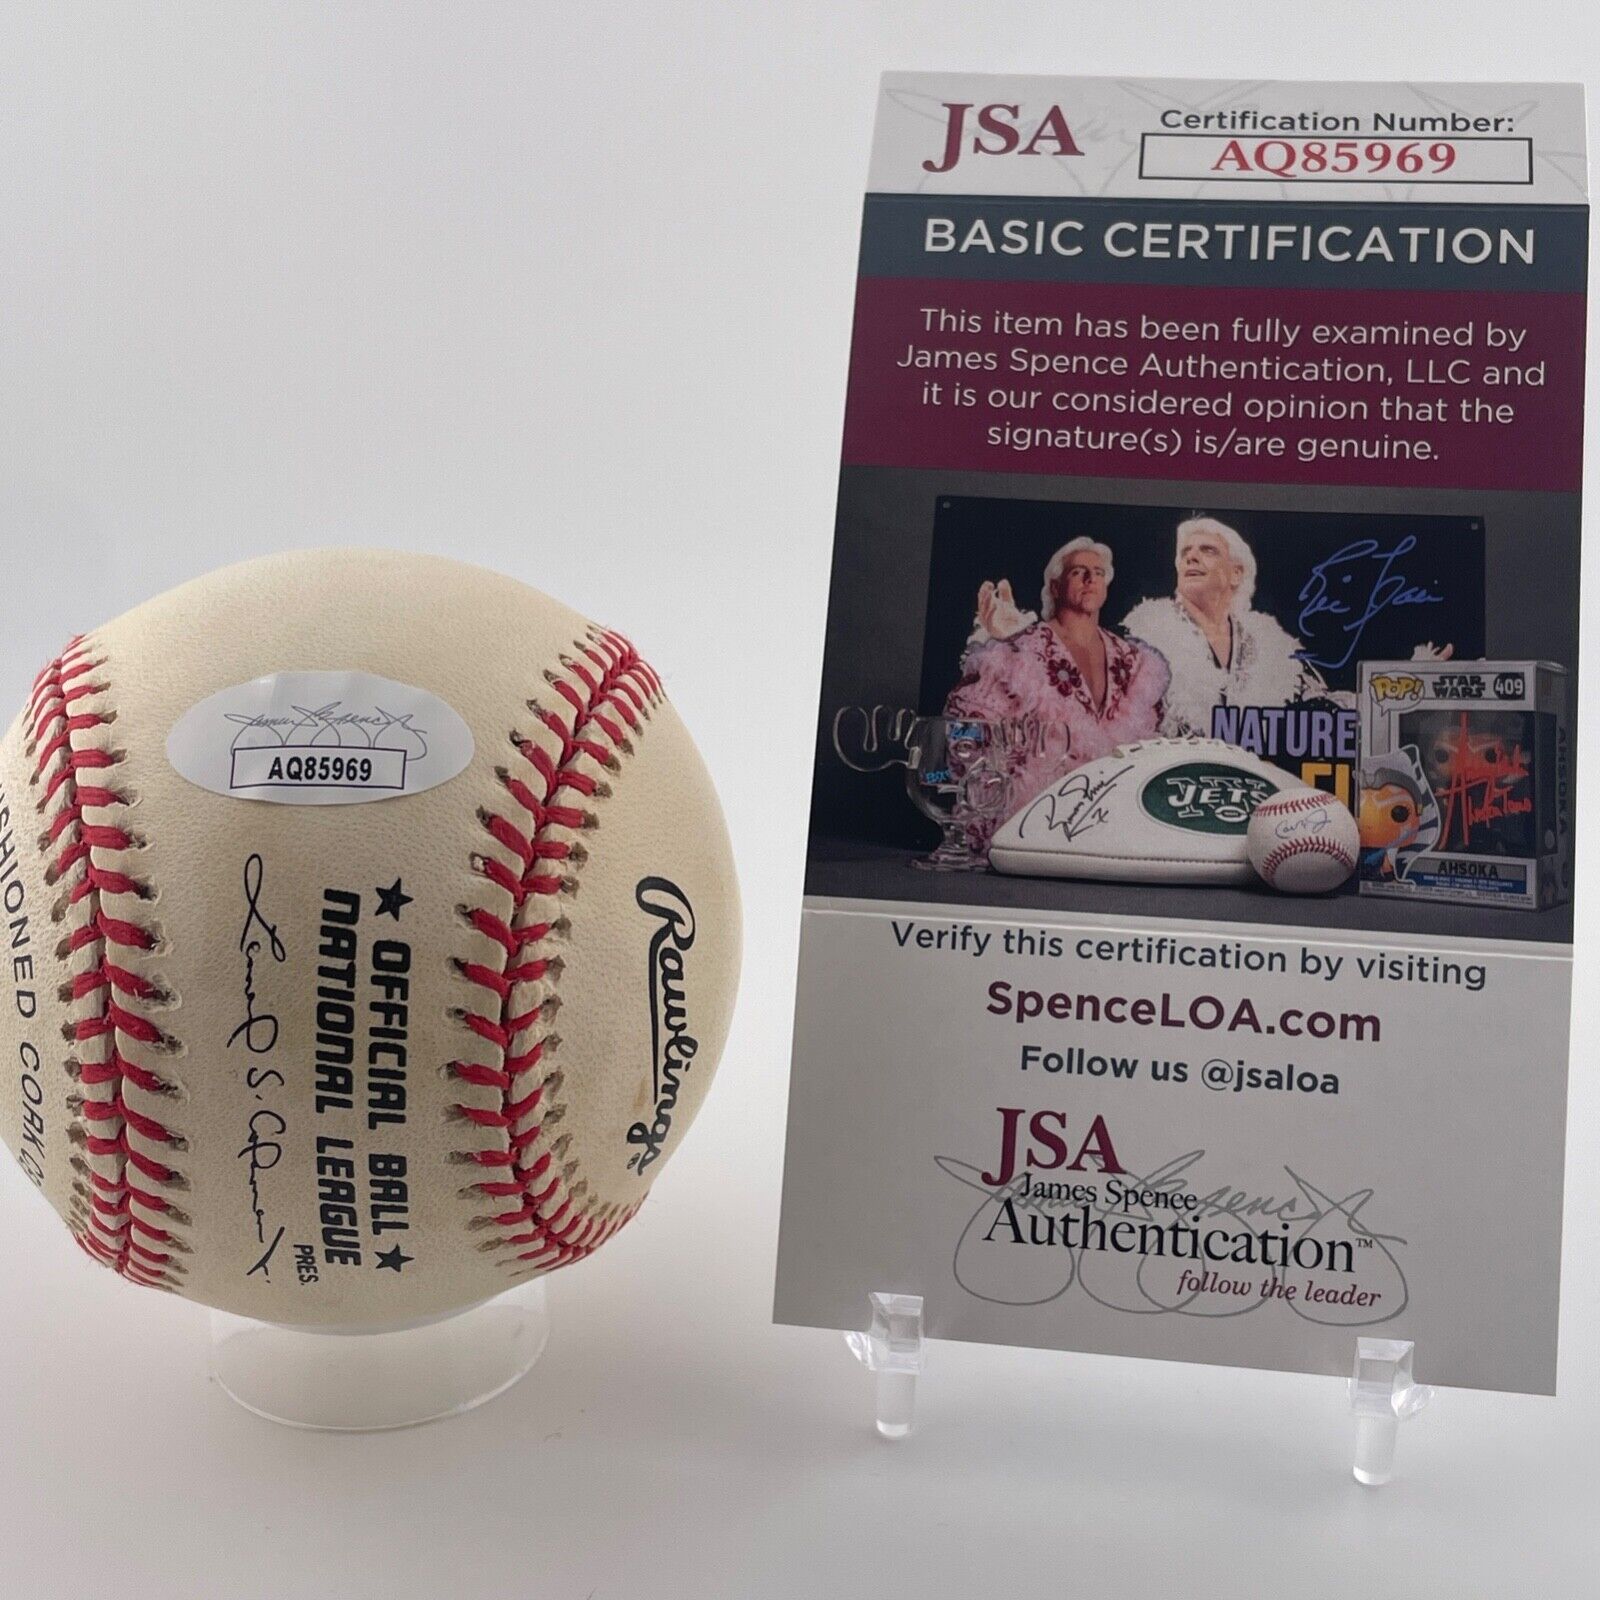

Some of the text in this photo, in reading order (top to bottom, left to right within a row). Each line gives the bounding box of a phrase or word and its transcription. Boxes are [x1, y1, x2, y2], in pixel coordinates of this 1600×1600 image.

[922, 103, 1085, 172] JSA
[1161, 110, 1513, 132] Certification Number:
[1211, 140, 1456, 176] AQ85969
[925, 219, 1533, 264] BASIC CERTIFICATION
[920, 309, 1526, 351] This item has been fully examined by
[897, 345, 1544, 385] James Spence Authentication, LLC and
[923, 382, 1513, 423] it is our considered opinion that the
[988, 422, 1438, 461] signature(s) is/are genuine.
[1370, 675, 1425, 701] POP!
[1432, 675, 1485, 686] STAR
[1433, 686, 1486, 699] WARS
[1495, 678, 1524, 696] 409
[1213, 707, 1357, 759] NATURE
[268, 757, 372, 782] AQ85969
[1438, 861, 1500, 878] AHSOKA
[0, 783, 36, 1018] SHIONED
[20, 1042, 46, 1159] CORK
[892, 921, 1485, 991] Verify this certification by visiting
[627, 876, 698, 1176] Rawlings
[987, 981, 1380, 1041] SpenceLOA.com
[315, 889, 361, 1265] NATIONAL LEAGUE
[368, 940, 411, 1235] OFFICIAL BALL
[1022, 1045, 1338, 1094] Follow us @jsaloa
[981, 1107, 1127, 1185] JSA
[1020, 1172, 1097, 1202] James
[1105, 1180, 1198, 1212] Spence
[293, 1244, 318, 1285] PRES.
[1177, 1269, 1381, 1307] follow the leader
